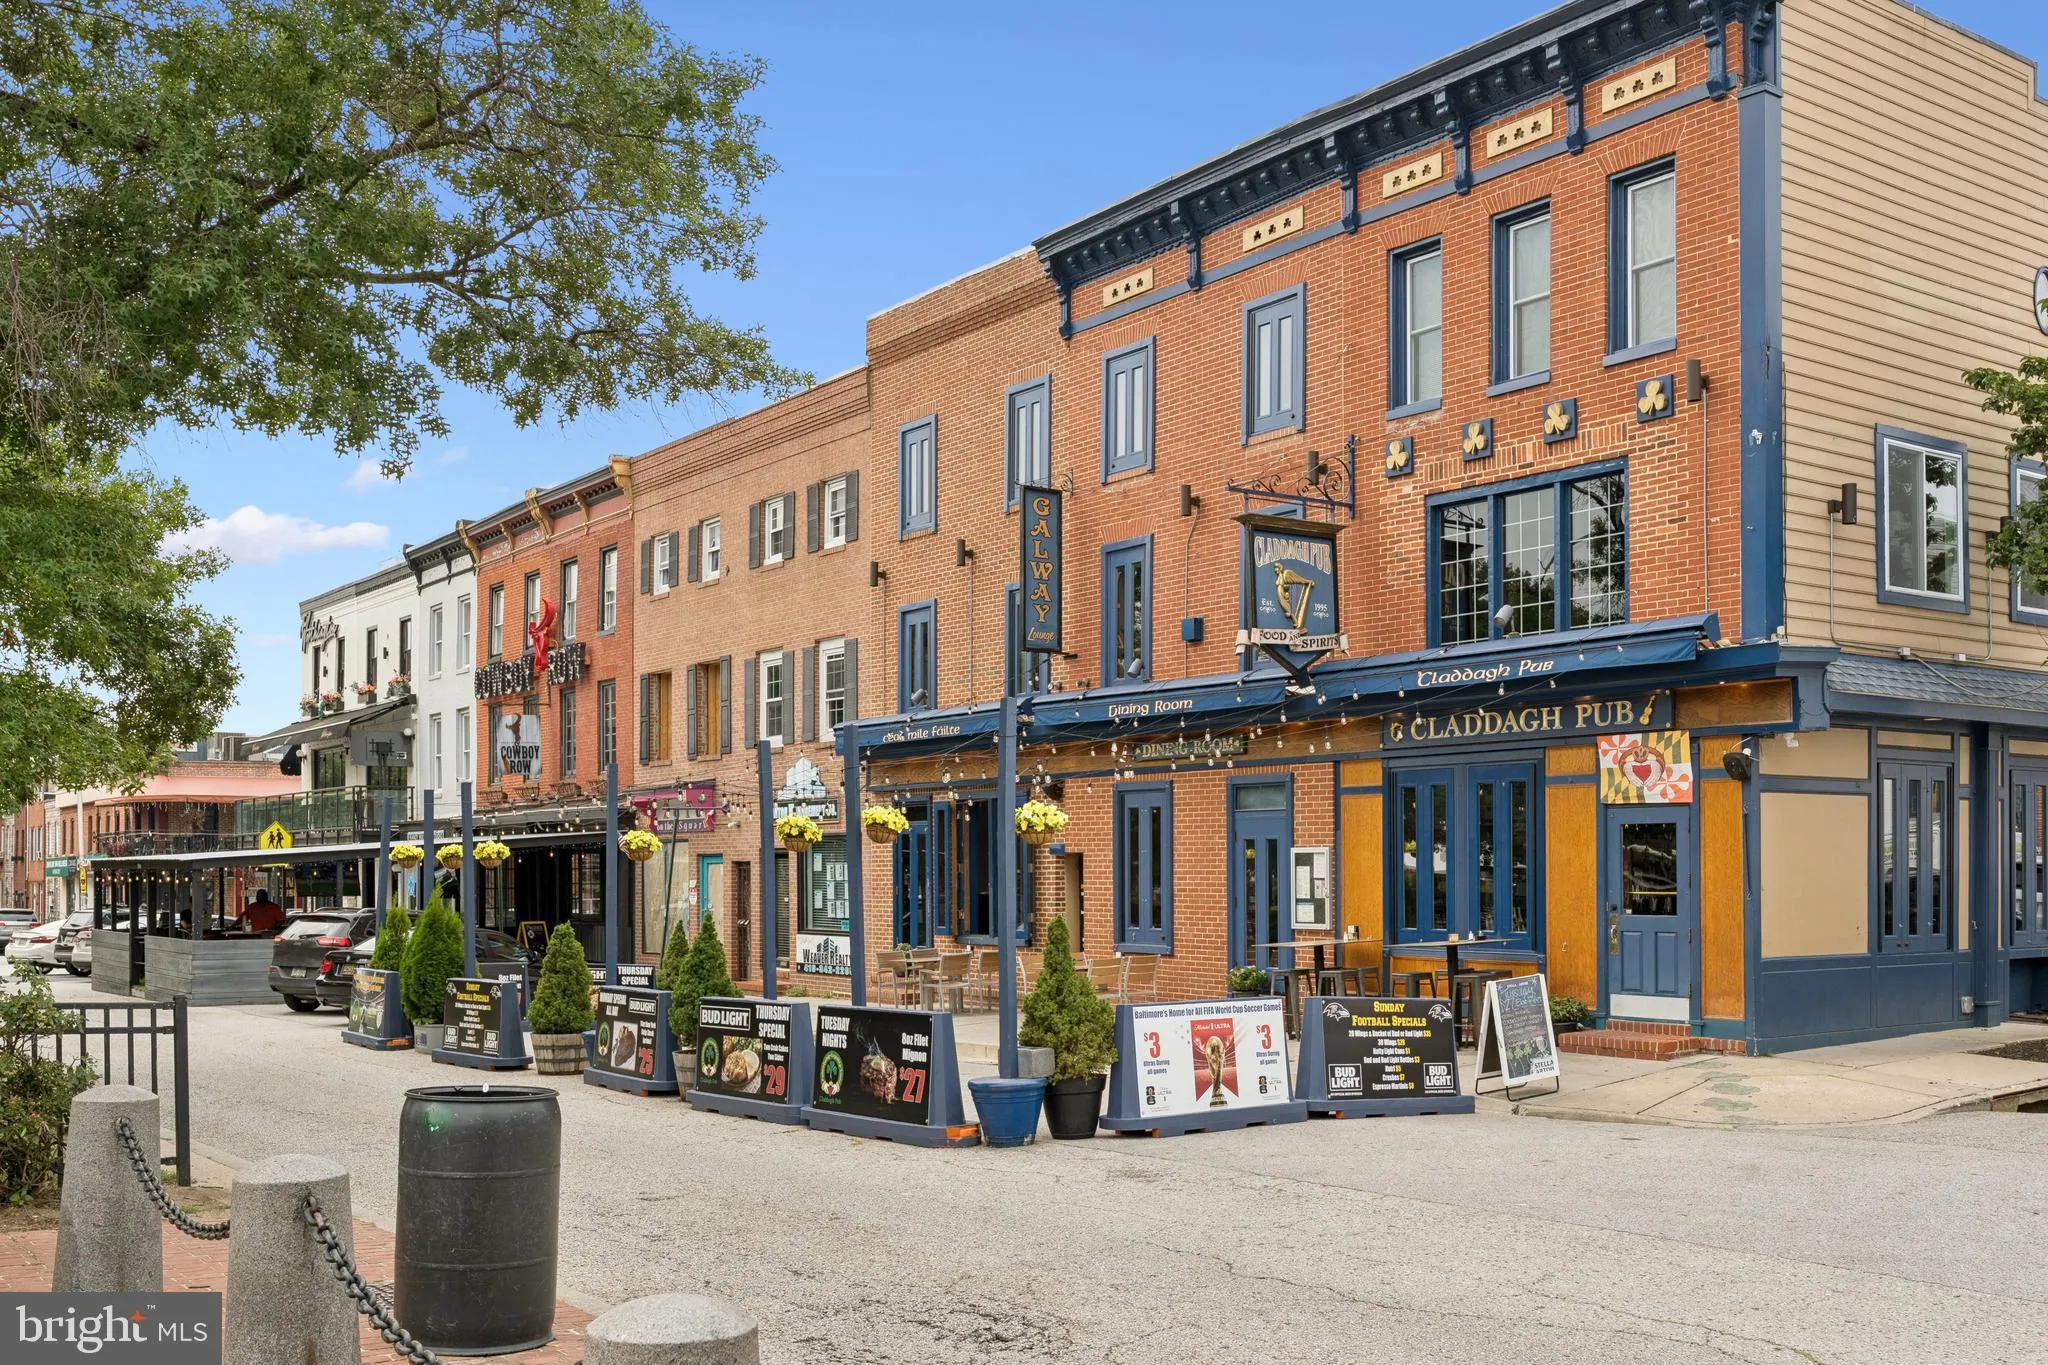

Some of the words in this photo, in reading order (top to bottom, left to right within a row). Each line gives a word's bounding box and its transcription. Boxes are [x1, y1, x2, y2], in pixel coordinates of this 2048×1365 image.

[1031, 497, 1053, 623] GALWAY
[1254, 536, 1310, 568] CLADDAGH
[1310, 543, 1331, 574] PUB
[1314, 604, 1328, 612] 1995
[1028, 627, 1055, 644] Lounge
[1260, 630, 1287, 640] FOOD
[1301, 636, 1340, 648] SPIRITS
[474, 656, 535, 699] COWBOY
[548, 642, 585, 685] ROW
[1418, 664, 1511, 687] Claddagh
[1108, 703, 1149, 717] Dining
[1154, 700, 1192, 712] Room
[1410, 706, 1562, 741] CLADDAGH
[1575, 700, 1634, 730] PUB
[501, 745, 539, 760] COWBOY
[1142, 741, 1188, 758] DINING
[1194, 737, 1235, 754] ROOM
[510, 760, 531, 773] ROW
[803, 949, 829, 965] WEAVER
[830, 951, 849, 966] REALT
[618, 966, 653, 975] THURSDAY
[622, 977, 649, 985] SPECIAL
[630, 1001, 640, 1010] BUD
[640, 1002, 654, 1012] LIGHT
[756, 1005, 790, 1021] THURSDAY
[1135, 1010, 1168, 1019] Baltimore's
[1169, 1009, 1185, 1017] Home
[1186, 1008, 1194, 1016] for
[1203, 1007, 1214, 1015] FIFA
[1215, 1006, 1231, 1014] World
[1232, 1006, 1243, 1014] Cup
[1244, 1004, 1262, 1012] Soccer
[1374, 1001, 1405, 1013] SUNDAY
[702, 1010, 720, 1024] BUD
[721, 1011, 748, 1026] LIGHT
[821, 1016, 850, 1032] TUESDAY
[1352, 1015, 1390, 1026] FOOTBALL
[1392, 1015, 1426, 1026] SPECIALS
[759, 1023, 785, 1039] SPECIAL
[1256, 1024, 1272, 1050] $3
[822, 1033, 847, 1049] NIGHTS
[901, 1033, 914, 1045] 8oz
[914, 1033, 929, 1047] Filet
[1144, 1031, 1161, 1058] $3
[902, 1048, 927, 1062] Mignon
[1335, 1067, 1356, 1077] BUD
[1429, 1065, 1447, 1075] BUD
[1535, 1060, 1553, 1068] STELLA
[764, 1064, 785, 1095] $29
[900, 1066, 926, 1104] $27
[1332, 1077, 1360, 1088] LIGHT
[1426, 1075, 1452, 1086] LIGHT
